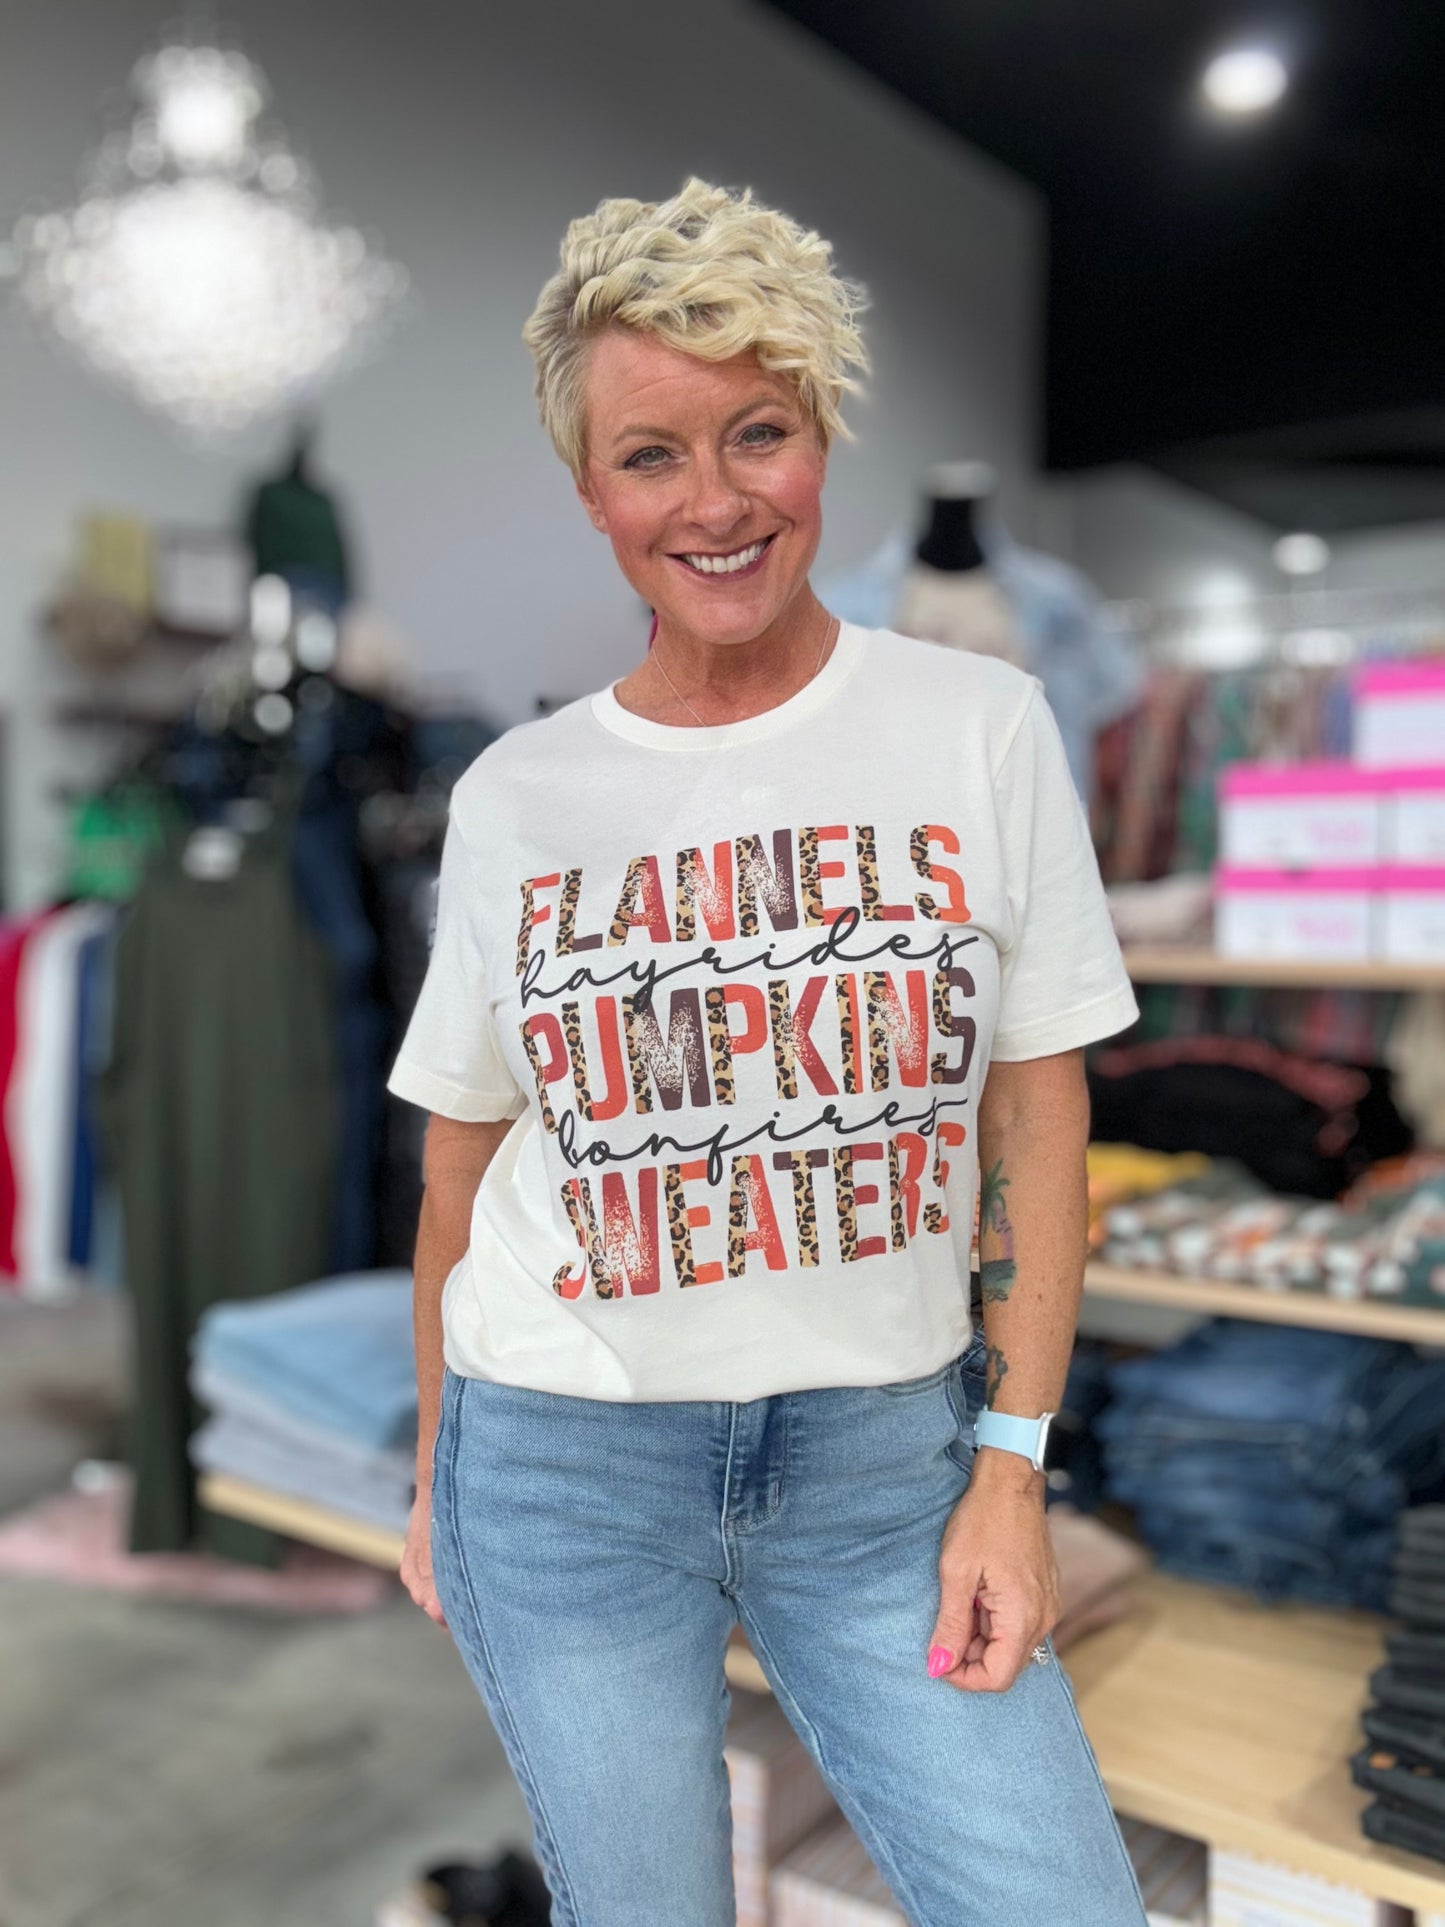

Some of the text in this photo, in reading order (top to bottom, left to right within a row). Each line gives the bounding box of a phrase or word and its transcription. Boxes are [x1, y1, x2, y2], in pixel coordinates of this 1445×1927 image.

[516, 824, 971, 976] FLANNELS
[520, 907, 979, 1010] hayrides
[519, 967, 976, 1134] PUMPKINS
[558, 1097, 968, 1186] bonfires
